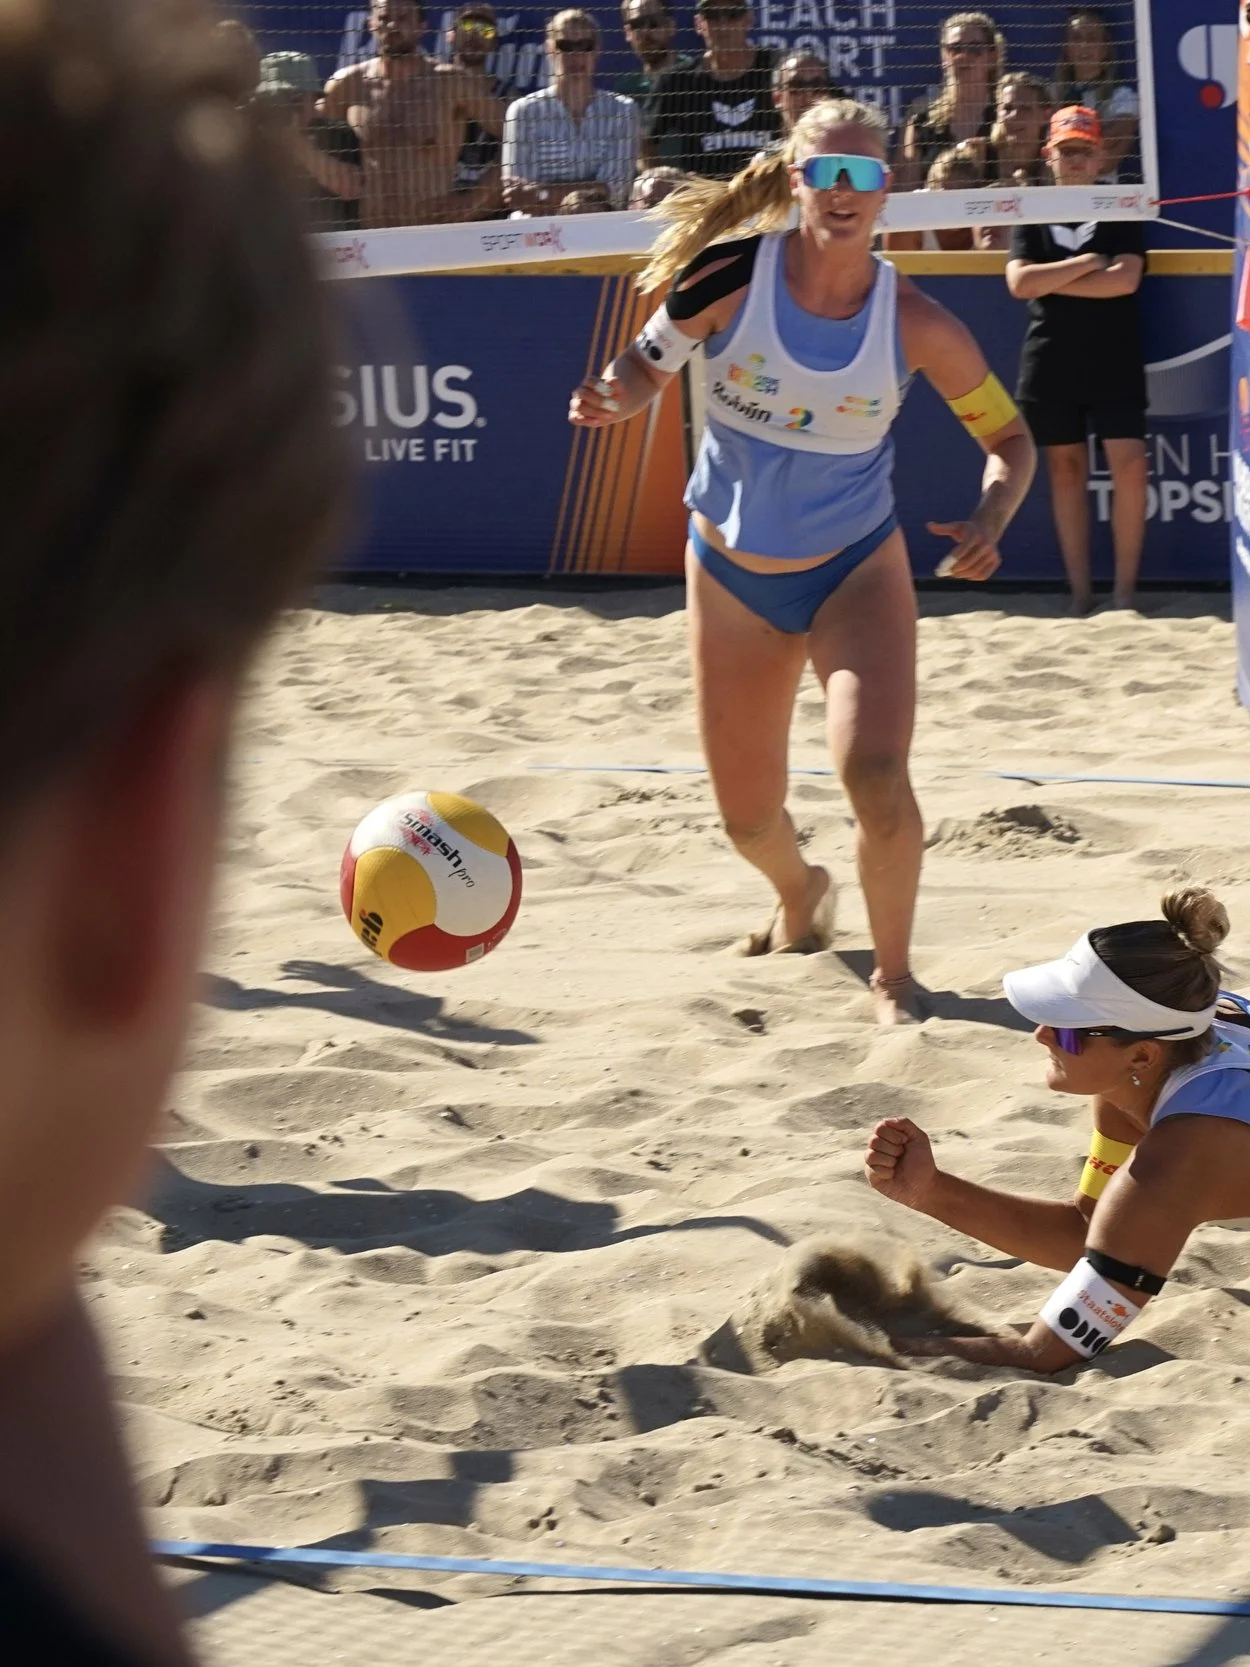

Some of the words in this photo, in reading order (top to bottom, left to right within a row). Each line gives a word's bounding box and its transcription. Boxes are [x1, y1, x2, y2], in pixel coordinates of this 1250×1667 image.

[365, 438, 427, 462] LIVE
[433, 438, 478, 462] FIT
[447, 867, 476, 888] pro
